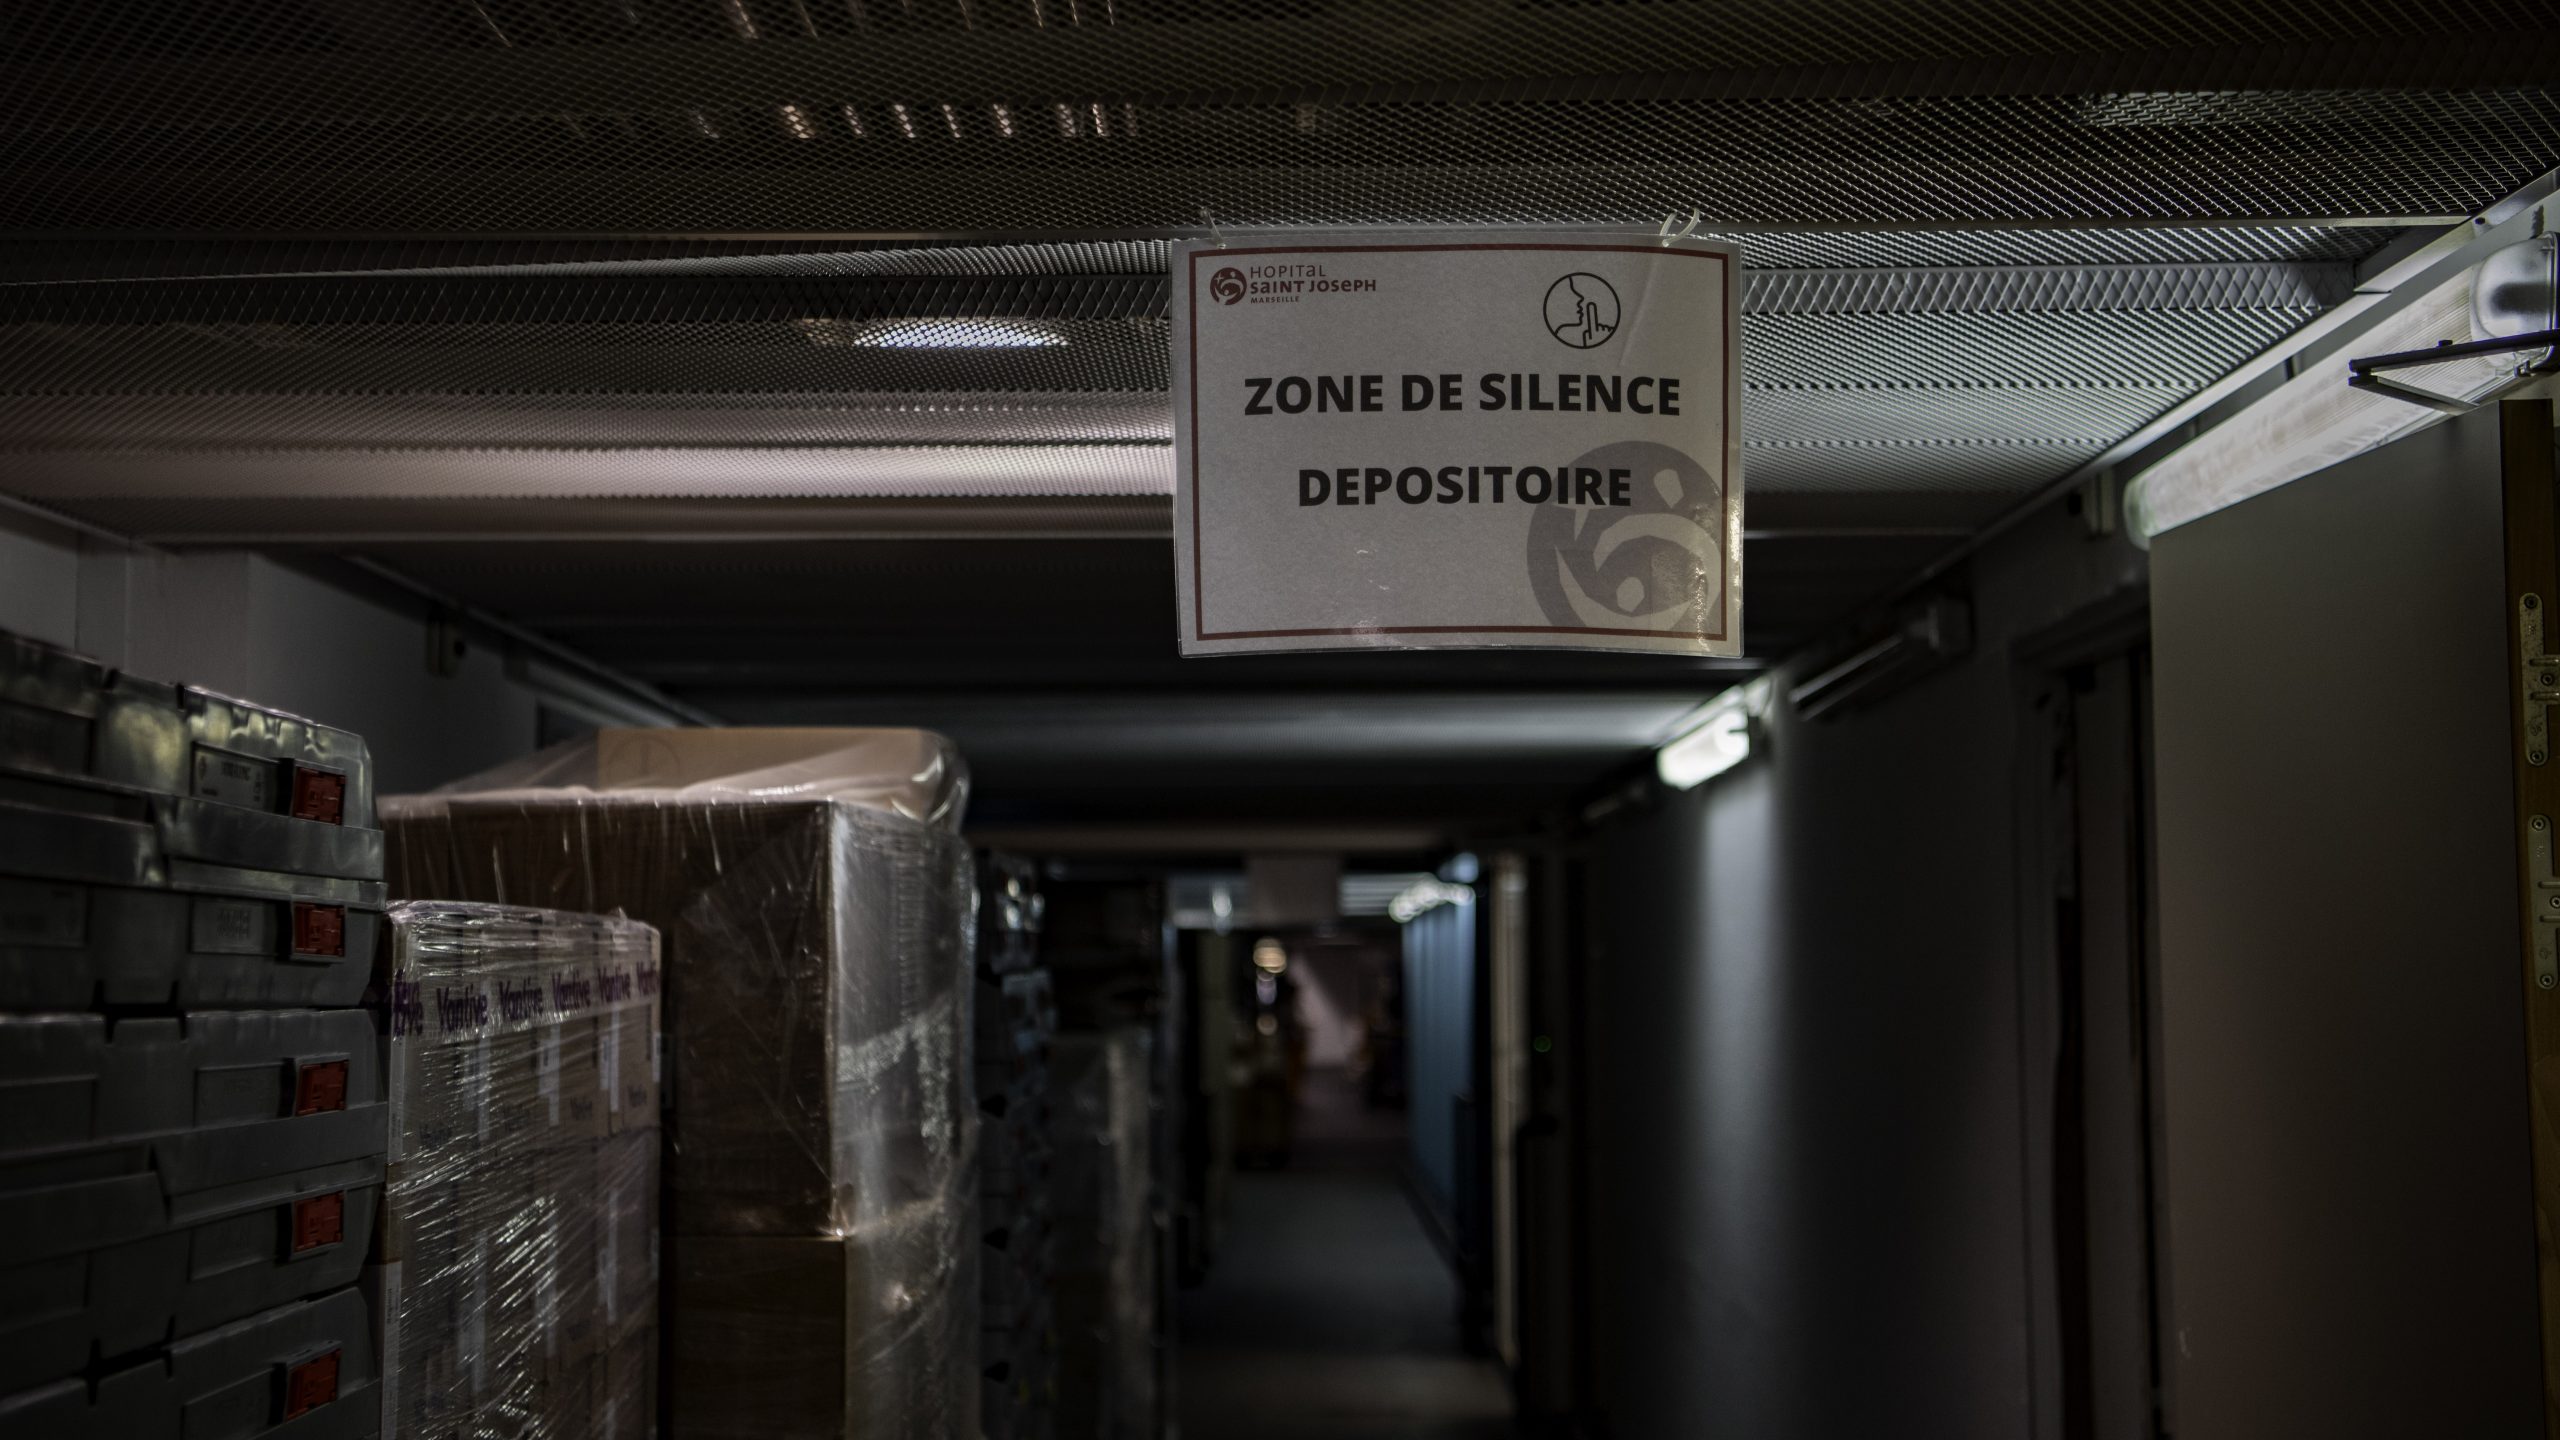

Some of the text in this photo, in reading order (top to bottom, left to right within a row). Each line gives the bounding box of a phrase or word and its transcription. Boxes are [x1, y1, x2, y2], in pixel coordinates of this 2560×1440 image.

[1250, 296, 1300, 304] MARSEILLE
[1244, 373, 1680, 416] ZONE DE SILENCE
[1299, 466, 1631, 507] DEPOSITOIRE
[437, 984, 488, 1032] Vantive
[499, 976, 543, 1021] Vantive
[552, 969, 592, 1011] Vantive
